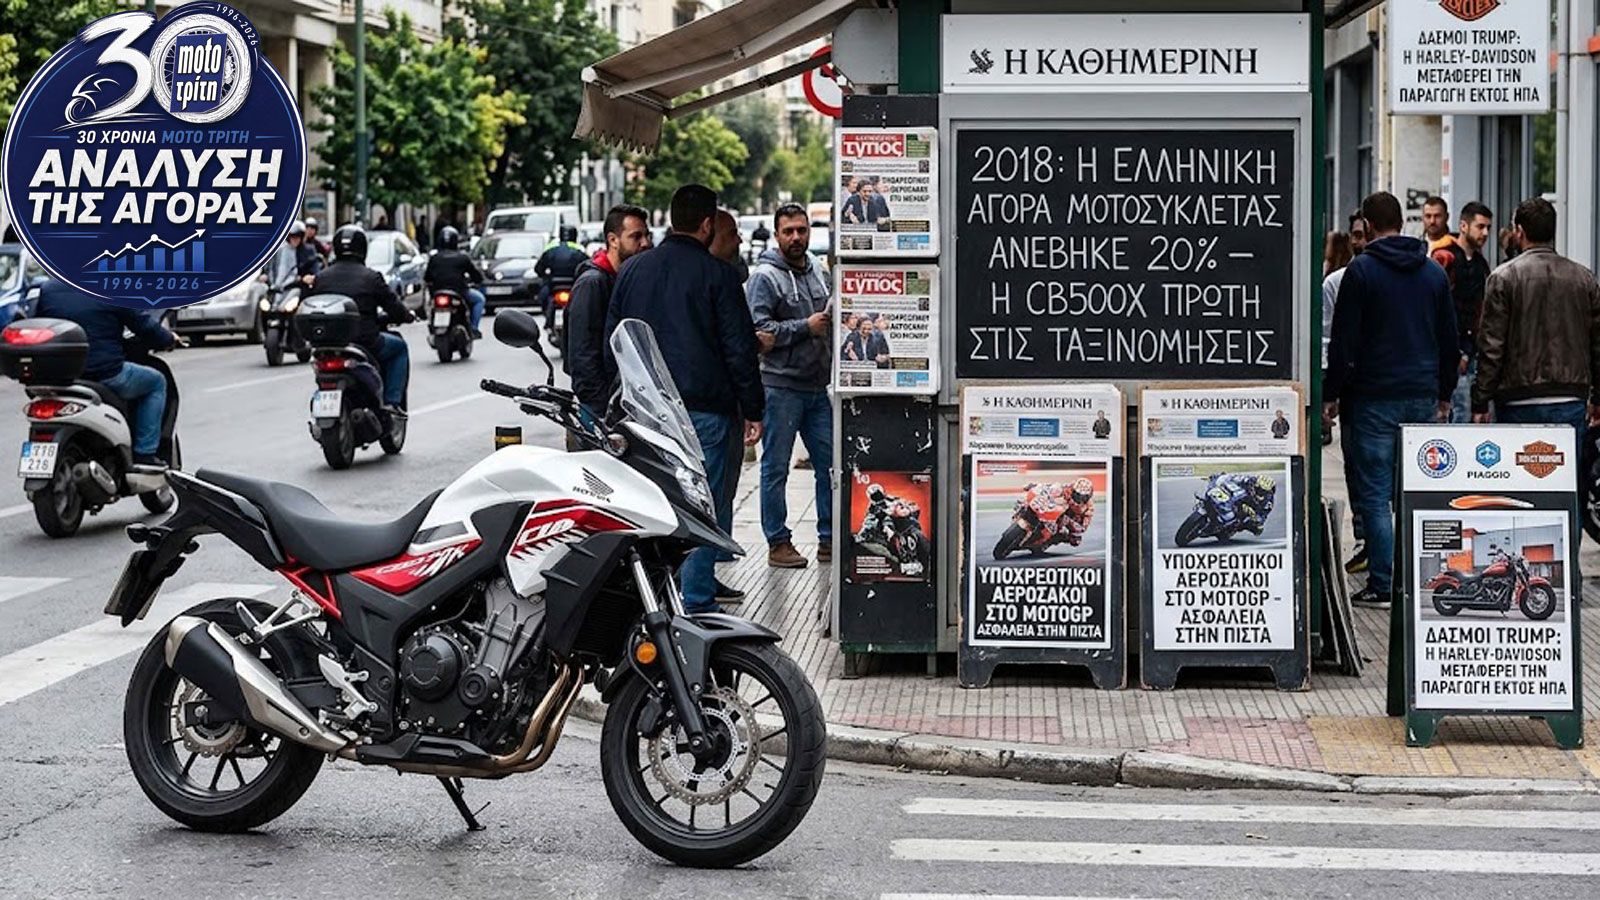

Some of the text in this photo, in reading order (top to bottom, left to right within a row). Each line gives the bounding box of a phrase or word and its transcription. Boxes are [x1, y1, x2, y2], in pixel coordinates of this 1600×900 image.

[1472, 30, 1521, 45] TRUMP:
[1004, 48, 1258, 75] Η ΚΑΘΗΜΕΡΙΝΗ
[1403, 50, 1412, 64] Η
[1417, 69, 1522, 83] ΜΕΤΑΦΕΡΕΙ ΤΗΝ
[1400, 88, 1466, 102] ΠΑΡΑΓΩΓΗ
[1514, 88, 1540, 102] ΗΠΑ
[972, 146, 1276, 184] 2018: Η ΕΛΛΗΝΙΚΗ
[967, 193, 1283, 227] ΑΓΟΡΑ ΜΟΤΟΣΥΚΛΕΤΑΣ
[988, 236, 1129, 270] ΑΝΕΒΗΚΕ
[1147, 236, 1219, 272] 20%
[992, 282, 1010, 315] Η
[1026, 281, 1147, 317] CB500X
[970, 328, 1034, 361] ΣΤΙΣ
[1047, 328, 1277, 366] ΤΑΞΙΝΟΜΗΣΕΙΣ
[993, 397, 1092, 409] Η ΚΑΘΗΜΕΡΙΝΗ
[1171, 399, 1270, 410] Η ΚΑΘΗΜΕΡΙΝΗ
[1467, 471, 1511, 479] PIAGGIO
[1162, 553, 1283, 569] ΥΠΟΧΡΕΩΤΙΚΟΙ
[1176, 572, 1269, 588] ΑΕΡΟΣΑΚΟΙ
[991, 586, 1088, 604] ΑΕΡΟΣΑΚΟΙ
[1165, 590, 1195, 606] ΣΤΟ
[985, 603, 1018, 622] ΣΤΟ
[1180, 609, 1267, 625] ΑΣΦΑΛΕΙΑ
[1036, 624, 1067, 638] ΣΤΗΝ
[1175, 627, 1272, 643] ΣΤΗΝ ΠΙΣΤΑ
[1425, 627, 1562, 645] ΔΑΣΜΟΙ TRUMP:
[1425, 647, 1435, 661] Η
[1520, 664, 1547, 678] ΤΗΝ
[1421, 680, 1490, 695] ΠΑΡΑΓΩΓΗ
[1539, 681, 1567, 695] ΗΠΑ
